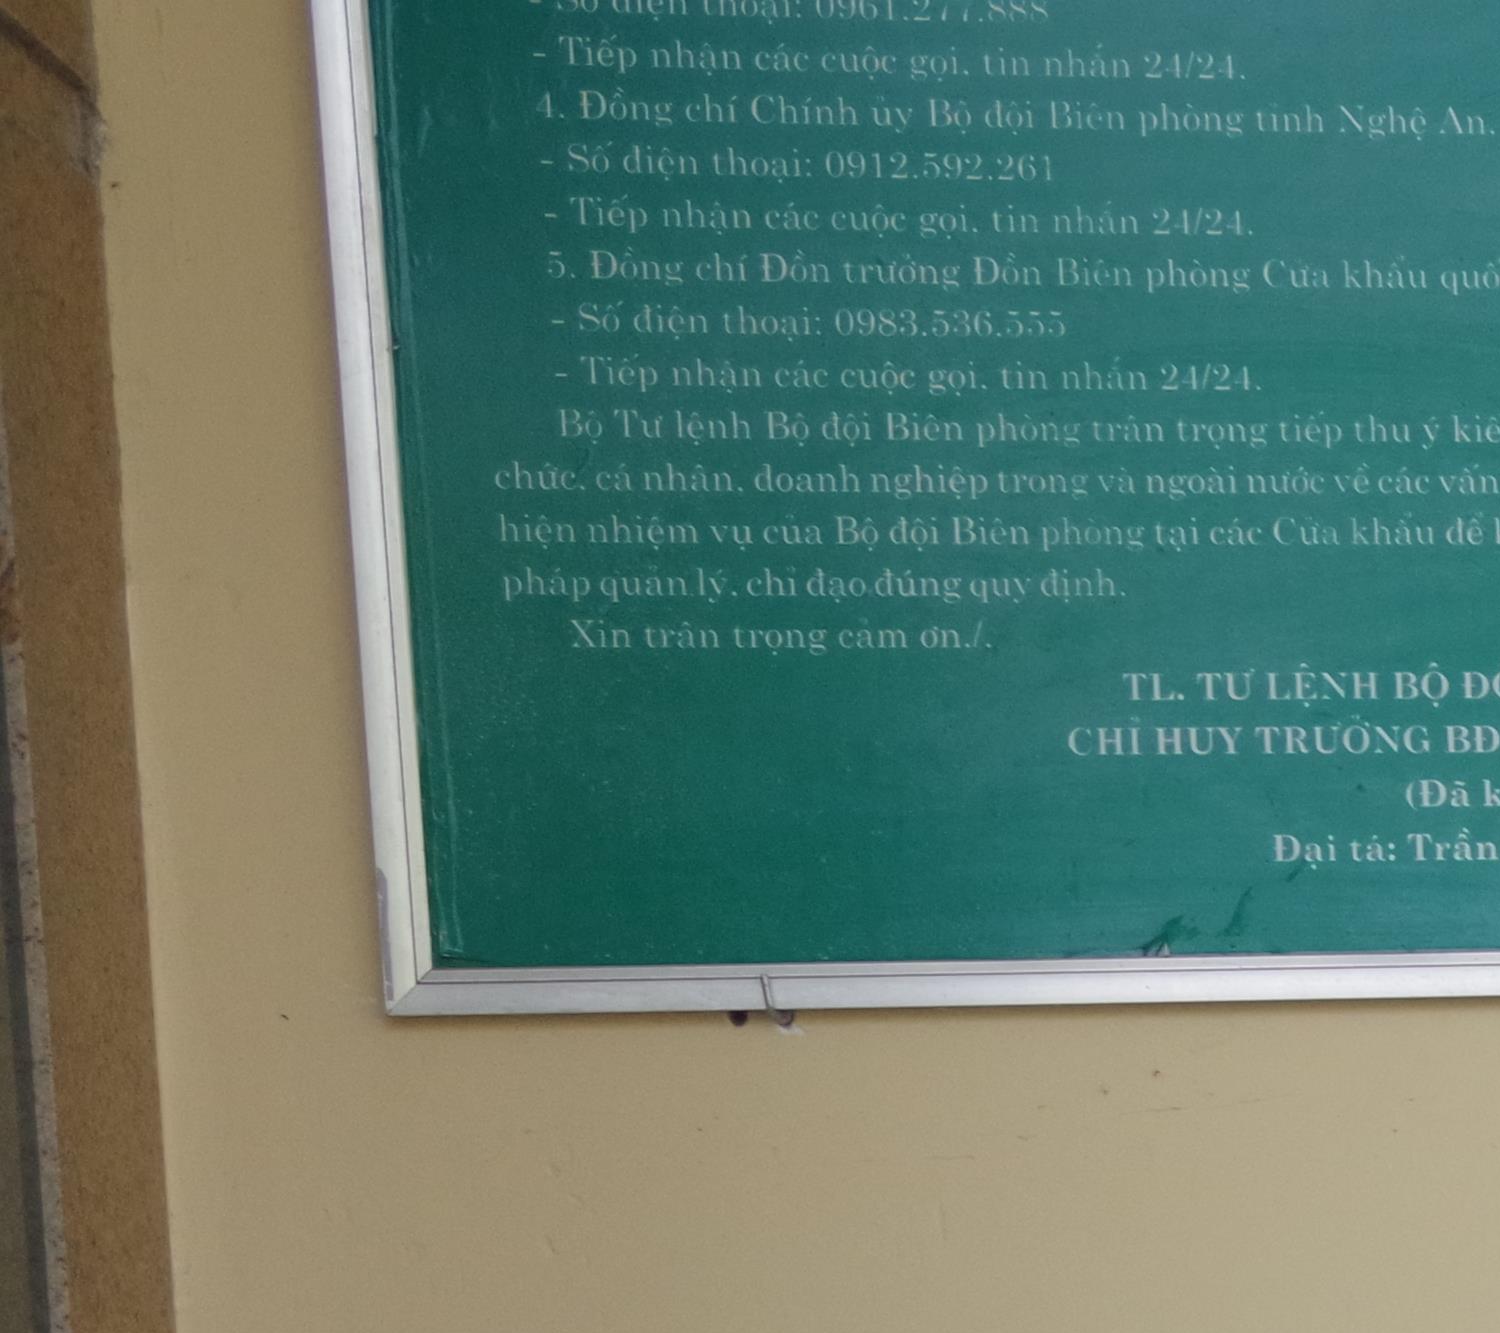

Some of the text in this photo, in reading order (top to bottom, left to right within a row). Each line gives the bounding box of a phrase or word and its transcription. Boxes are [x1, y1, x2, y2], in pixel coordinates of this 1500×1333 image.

[537, 92, 564, 118] 4.
[579, 87, 672, 126] Đồng
[685, 93, 737, 123] chí
[751, 95, 858, 125] Chính
[929, 98, 971, 134] Bộ
[984, 100, 1033, 135] đội
[1051, 101, 1124, 129] Biên
[1140, 103, 1243, 137] phòng
[1340, 105, 1426, 140] Nghệ
[1440, 107, 1495, 135] An.
[568, 143, 1051, 183] Số điện thoại: 0912.592.261
[571, 619, 631, 648] Xin
[644, 621, 719, 648] trân
[733, 627, 827, 655] trọng
[838, 621, 908, 648] cảm
[1123, 673, 1184, 700] TL.
[1197, 670, 1250, 700] TƯ
[1268, 663, 1377, 707] LỆNH
[1395, 662, 1449, 707] BỘ
[1068, 720, 1140, 755] CHỈ
[1156, 727, 1241, 755] HUY
[1255, 720, 1430, 754] TRƯỞNG
[1406, 780, 1470, 807] (Đã
[1274, 834, 1336, 869] Đại
[1350, 835, 1396, 861] tá:
[1407, 828, 1498, 861] Trần
